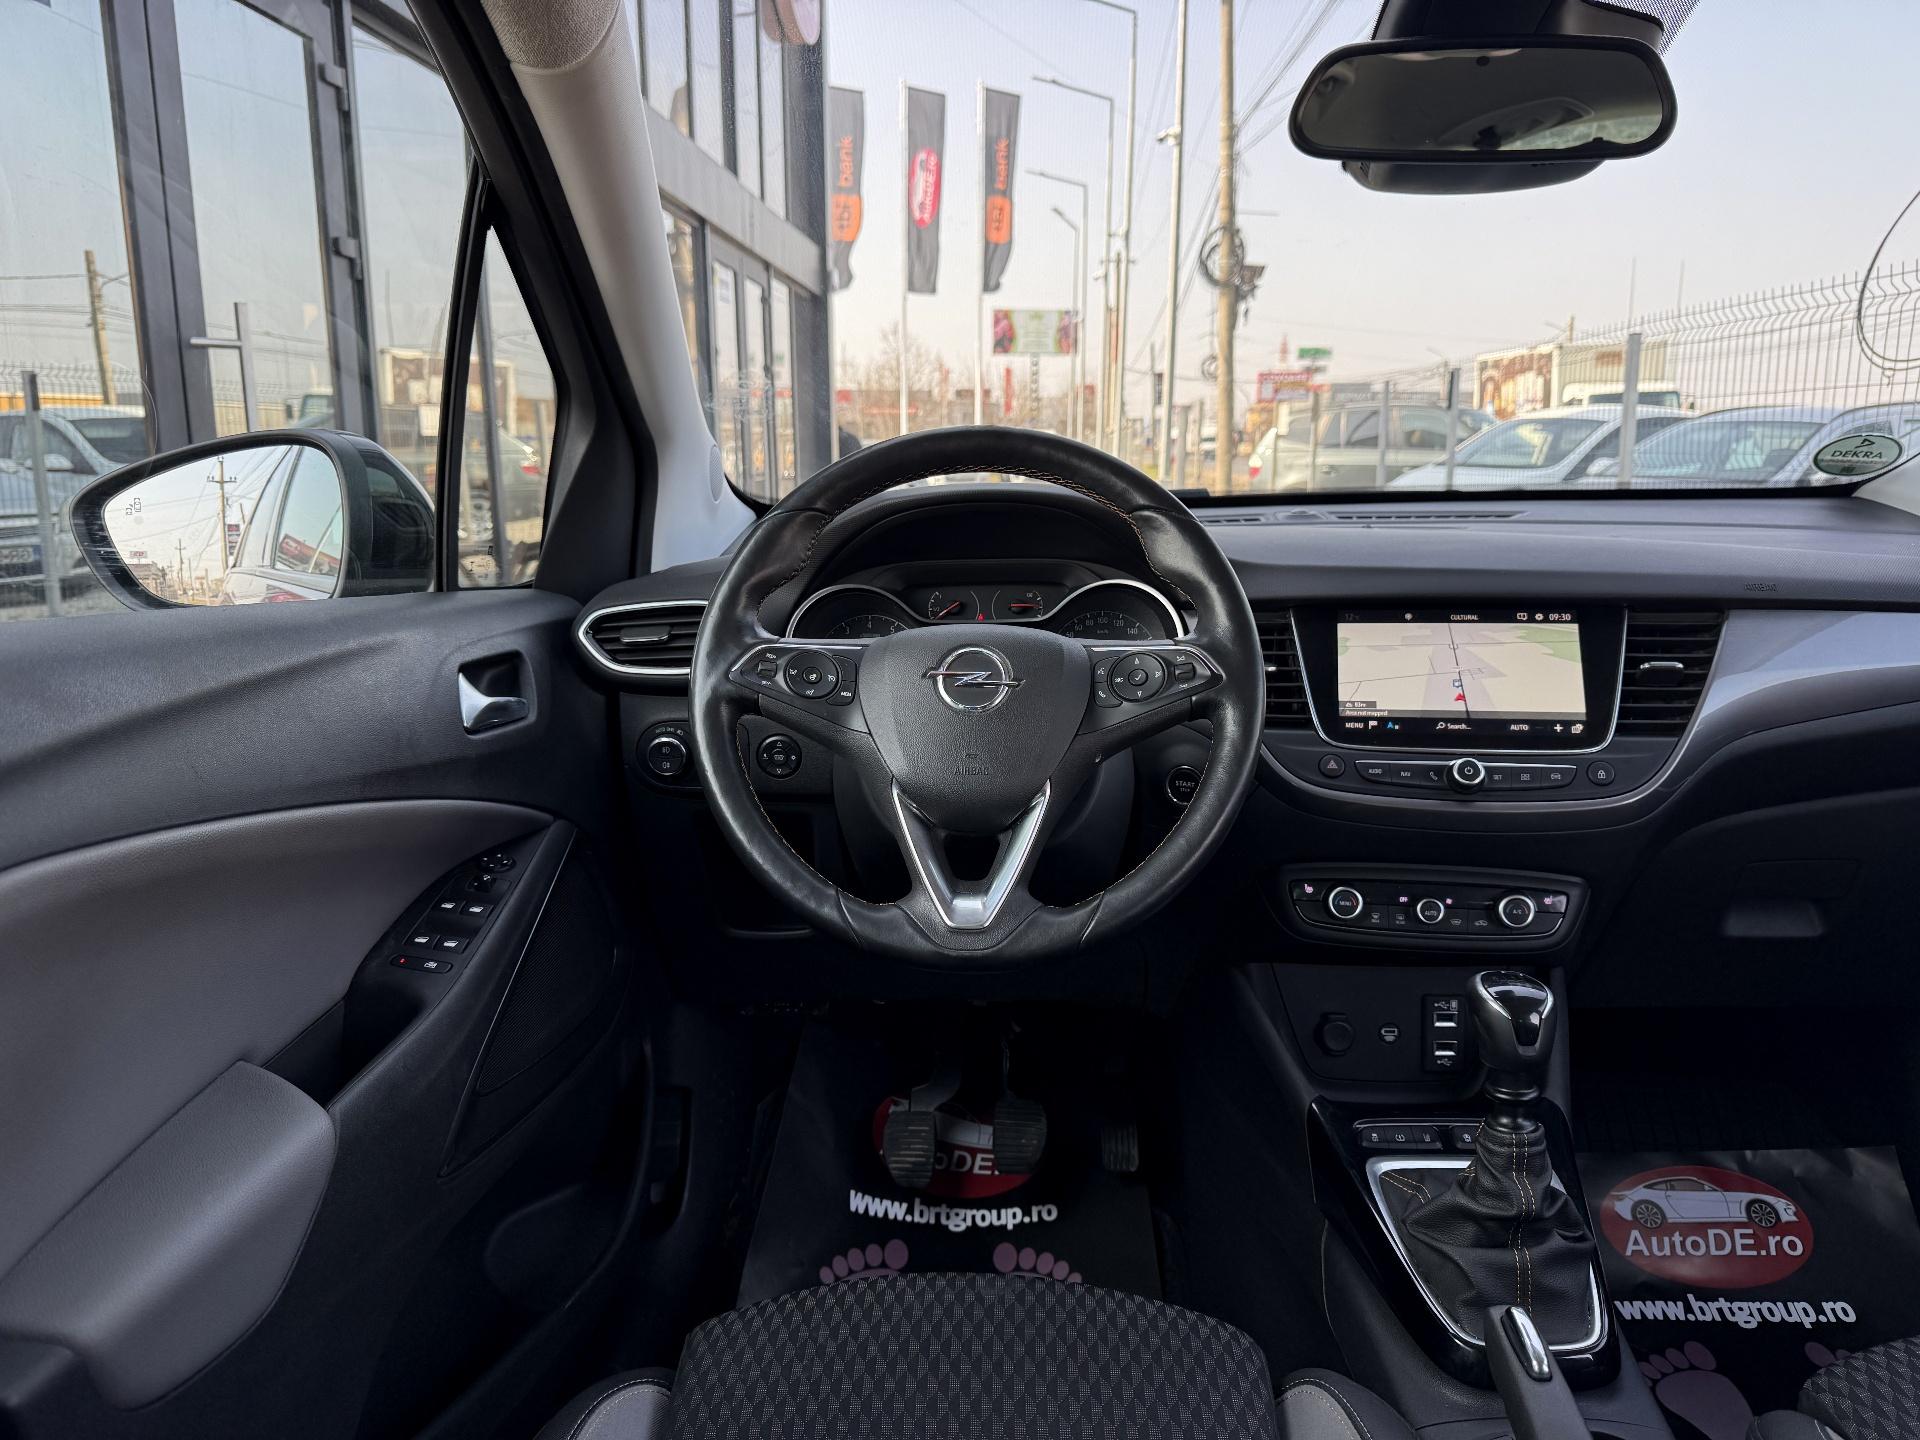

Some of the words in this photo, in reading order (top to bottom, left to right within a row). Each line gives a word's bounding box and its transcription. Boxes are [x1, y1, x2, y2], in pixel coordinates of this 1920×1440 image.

[839, 135, 853, 188] bank
[995, 137, 1009, 190] bank
[1831, 449, 1883, 460] DEKRA
[1450, 613, 1479, 621] CULTURAL
[1548, 612, 1572, 621] 09:30
[1113, 619, 1124, 627] 120
[1127, 627, 1138, 635] 140
[1175, 780, 1196, 788] START
[849, 1189, 1059, 1232] www.brtgroup.ro
[1625, 1228, 1805, 1257] AutoDE.ro
[1614, 1294, 1857, 1329] www.brtgroup.ro
